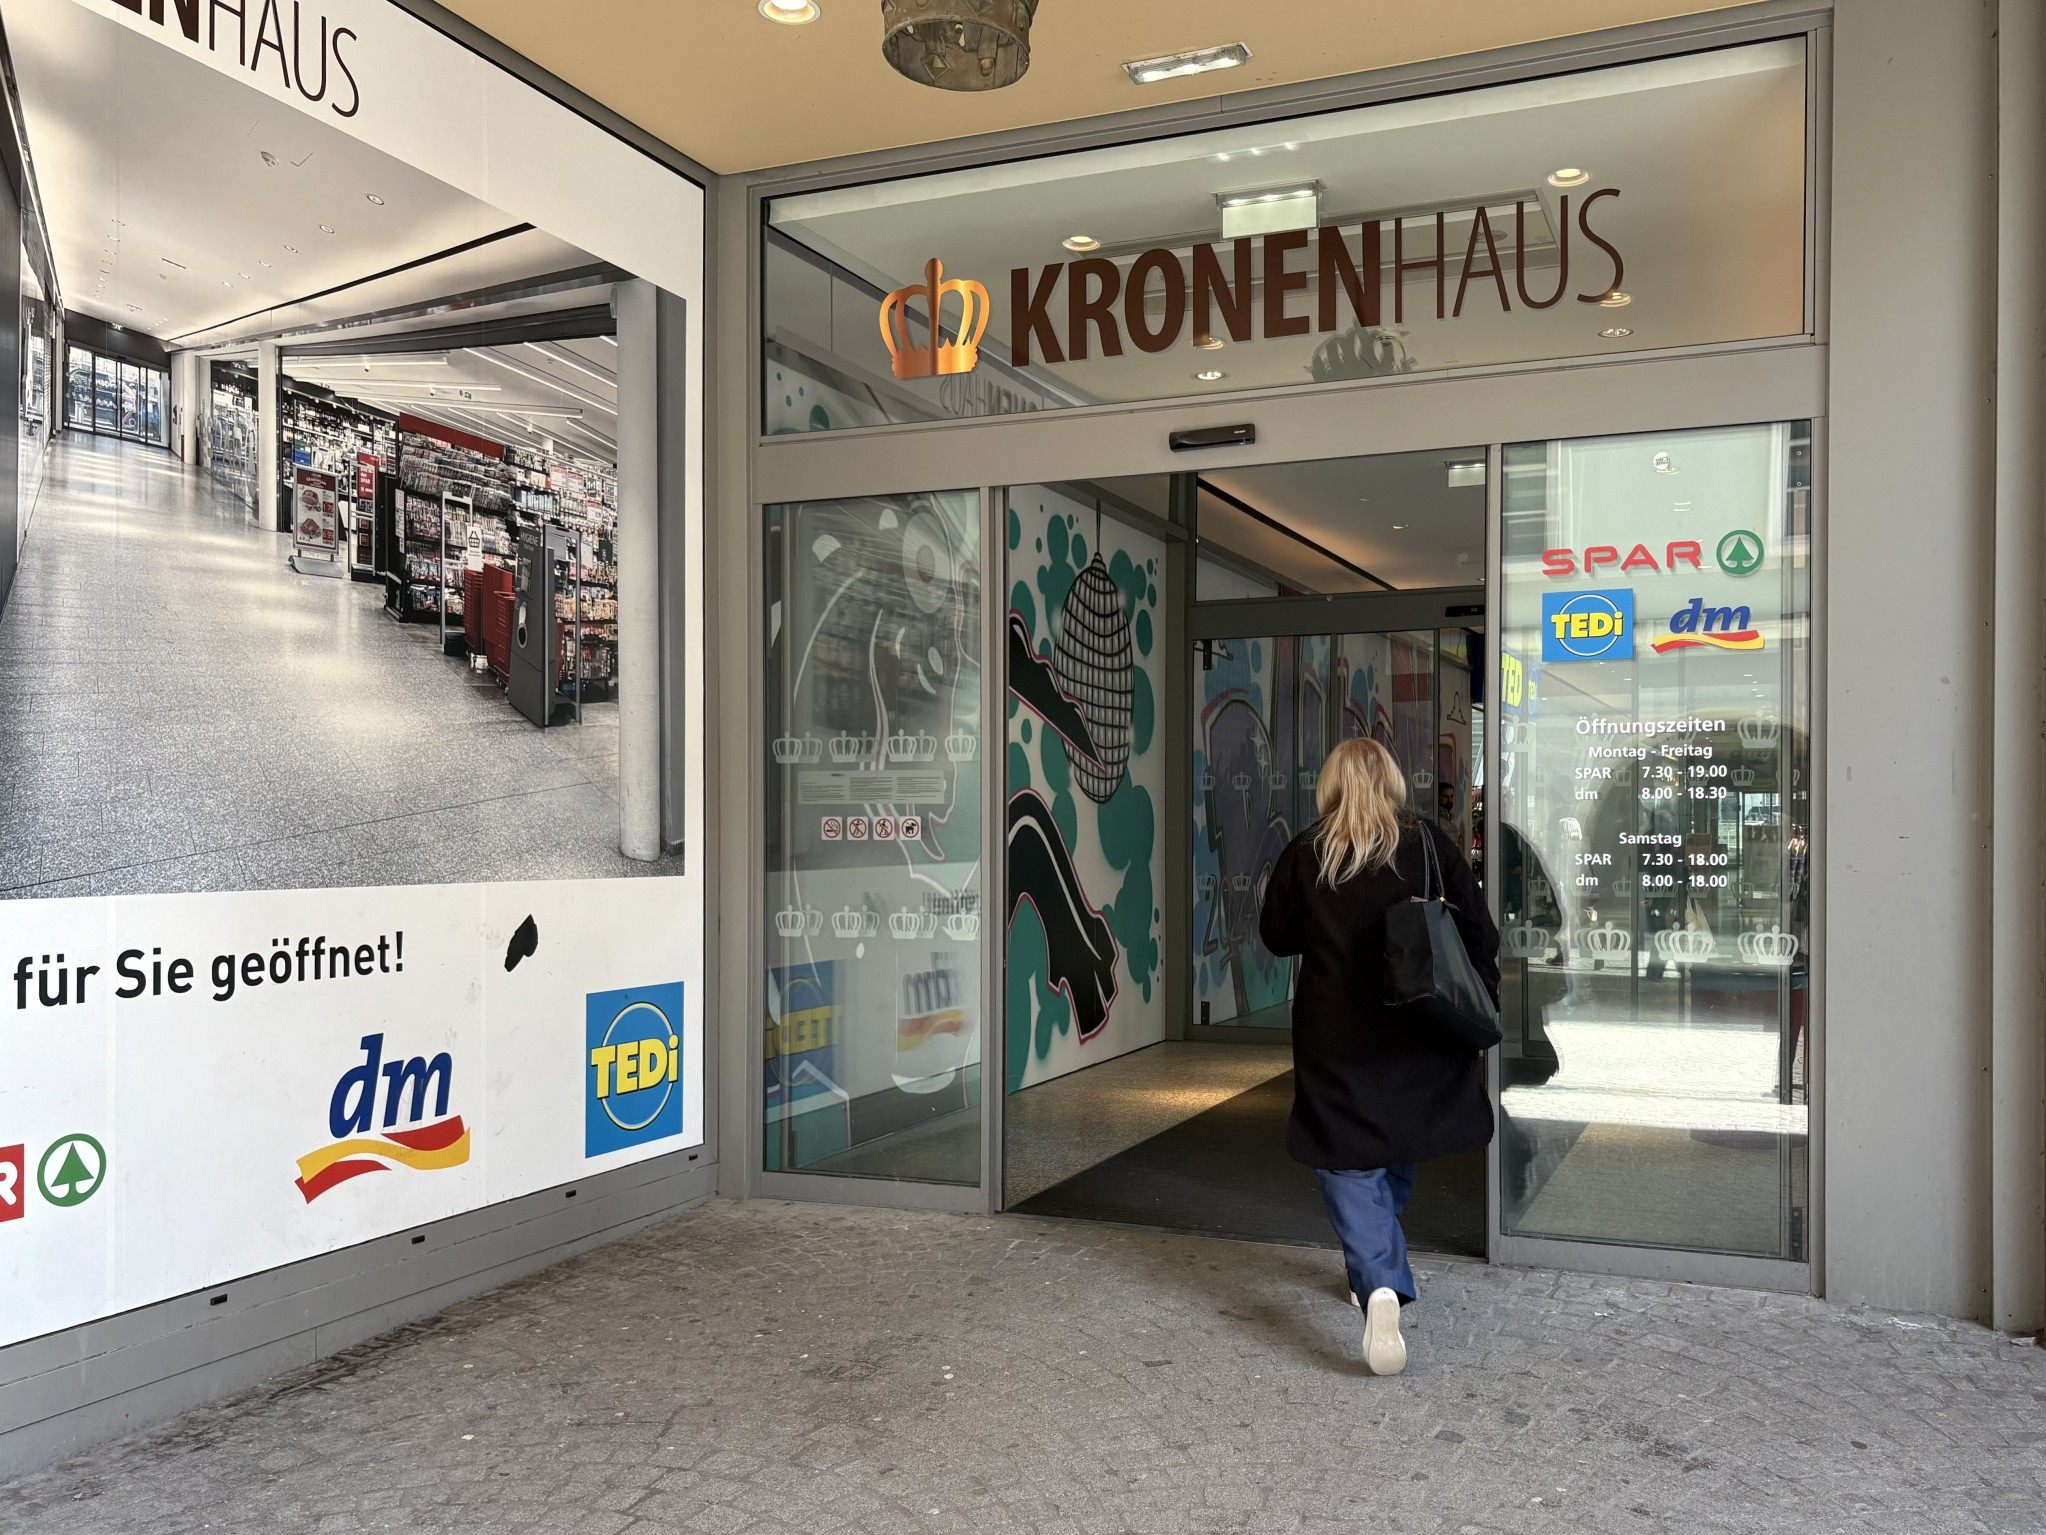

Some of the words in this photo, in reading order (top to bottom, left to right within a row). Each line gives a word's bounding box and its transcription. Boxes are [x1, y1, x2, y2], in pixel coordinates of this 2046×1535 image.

[1011, 188, 1624, 366] KRONENHAUS
[1542, 540, 1702, 576] SPAR
[1550, 611, 1623, 639] TEDi
[1669, 598, 1751, 634] dm
[1576, 716, 1726, 737] Öffnungszeiten
[1588, 745, 1647, 759] Montag
[1661, 744, 1713, 759] Freitag
[1575, 767, 1612, 779] SPAR
[1642, 766, 1673, 779] 7.30
[1688, 765, 1727, 778] 19.00
[1575, 787, 1598, 800] dm
[1642, 787, 1673, 800] 8.00
[1688, 786, 1727, 799] 18.30
[1619, 832, 1682, 847] Samstag
[1575, 854, 1612, 866] SPAR
[1642, 853, 1673, 866] 7.30
[1688, 853, 1728, 866] 18.00
[1575, 874, 1598, 887] dm
[1642, 874, 1673, 887] 8.00
[1688, 874, 1728, 887] 18.00
[13, 956, 101, 1010] für
[115, 946, 194, 998] Sie
[212, 931, 405, 1001] geöffnet!
[589, 1033, 680, 1099] TEDi
[329, 1033, 453, 1139] dm
